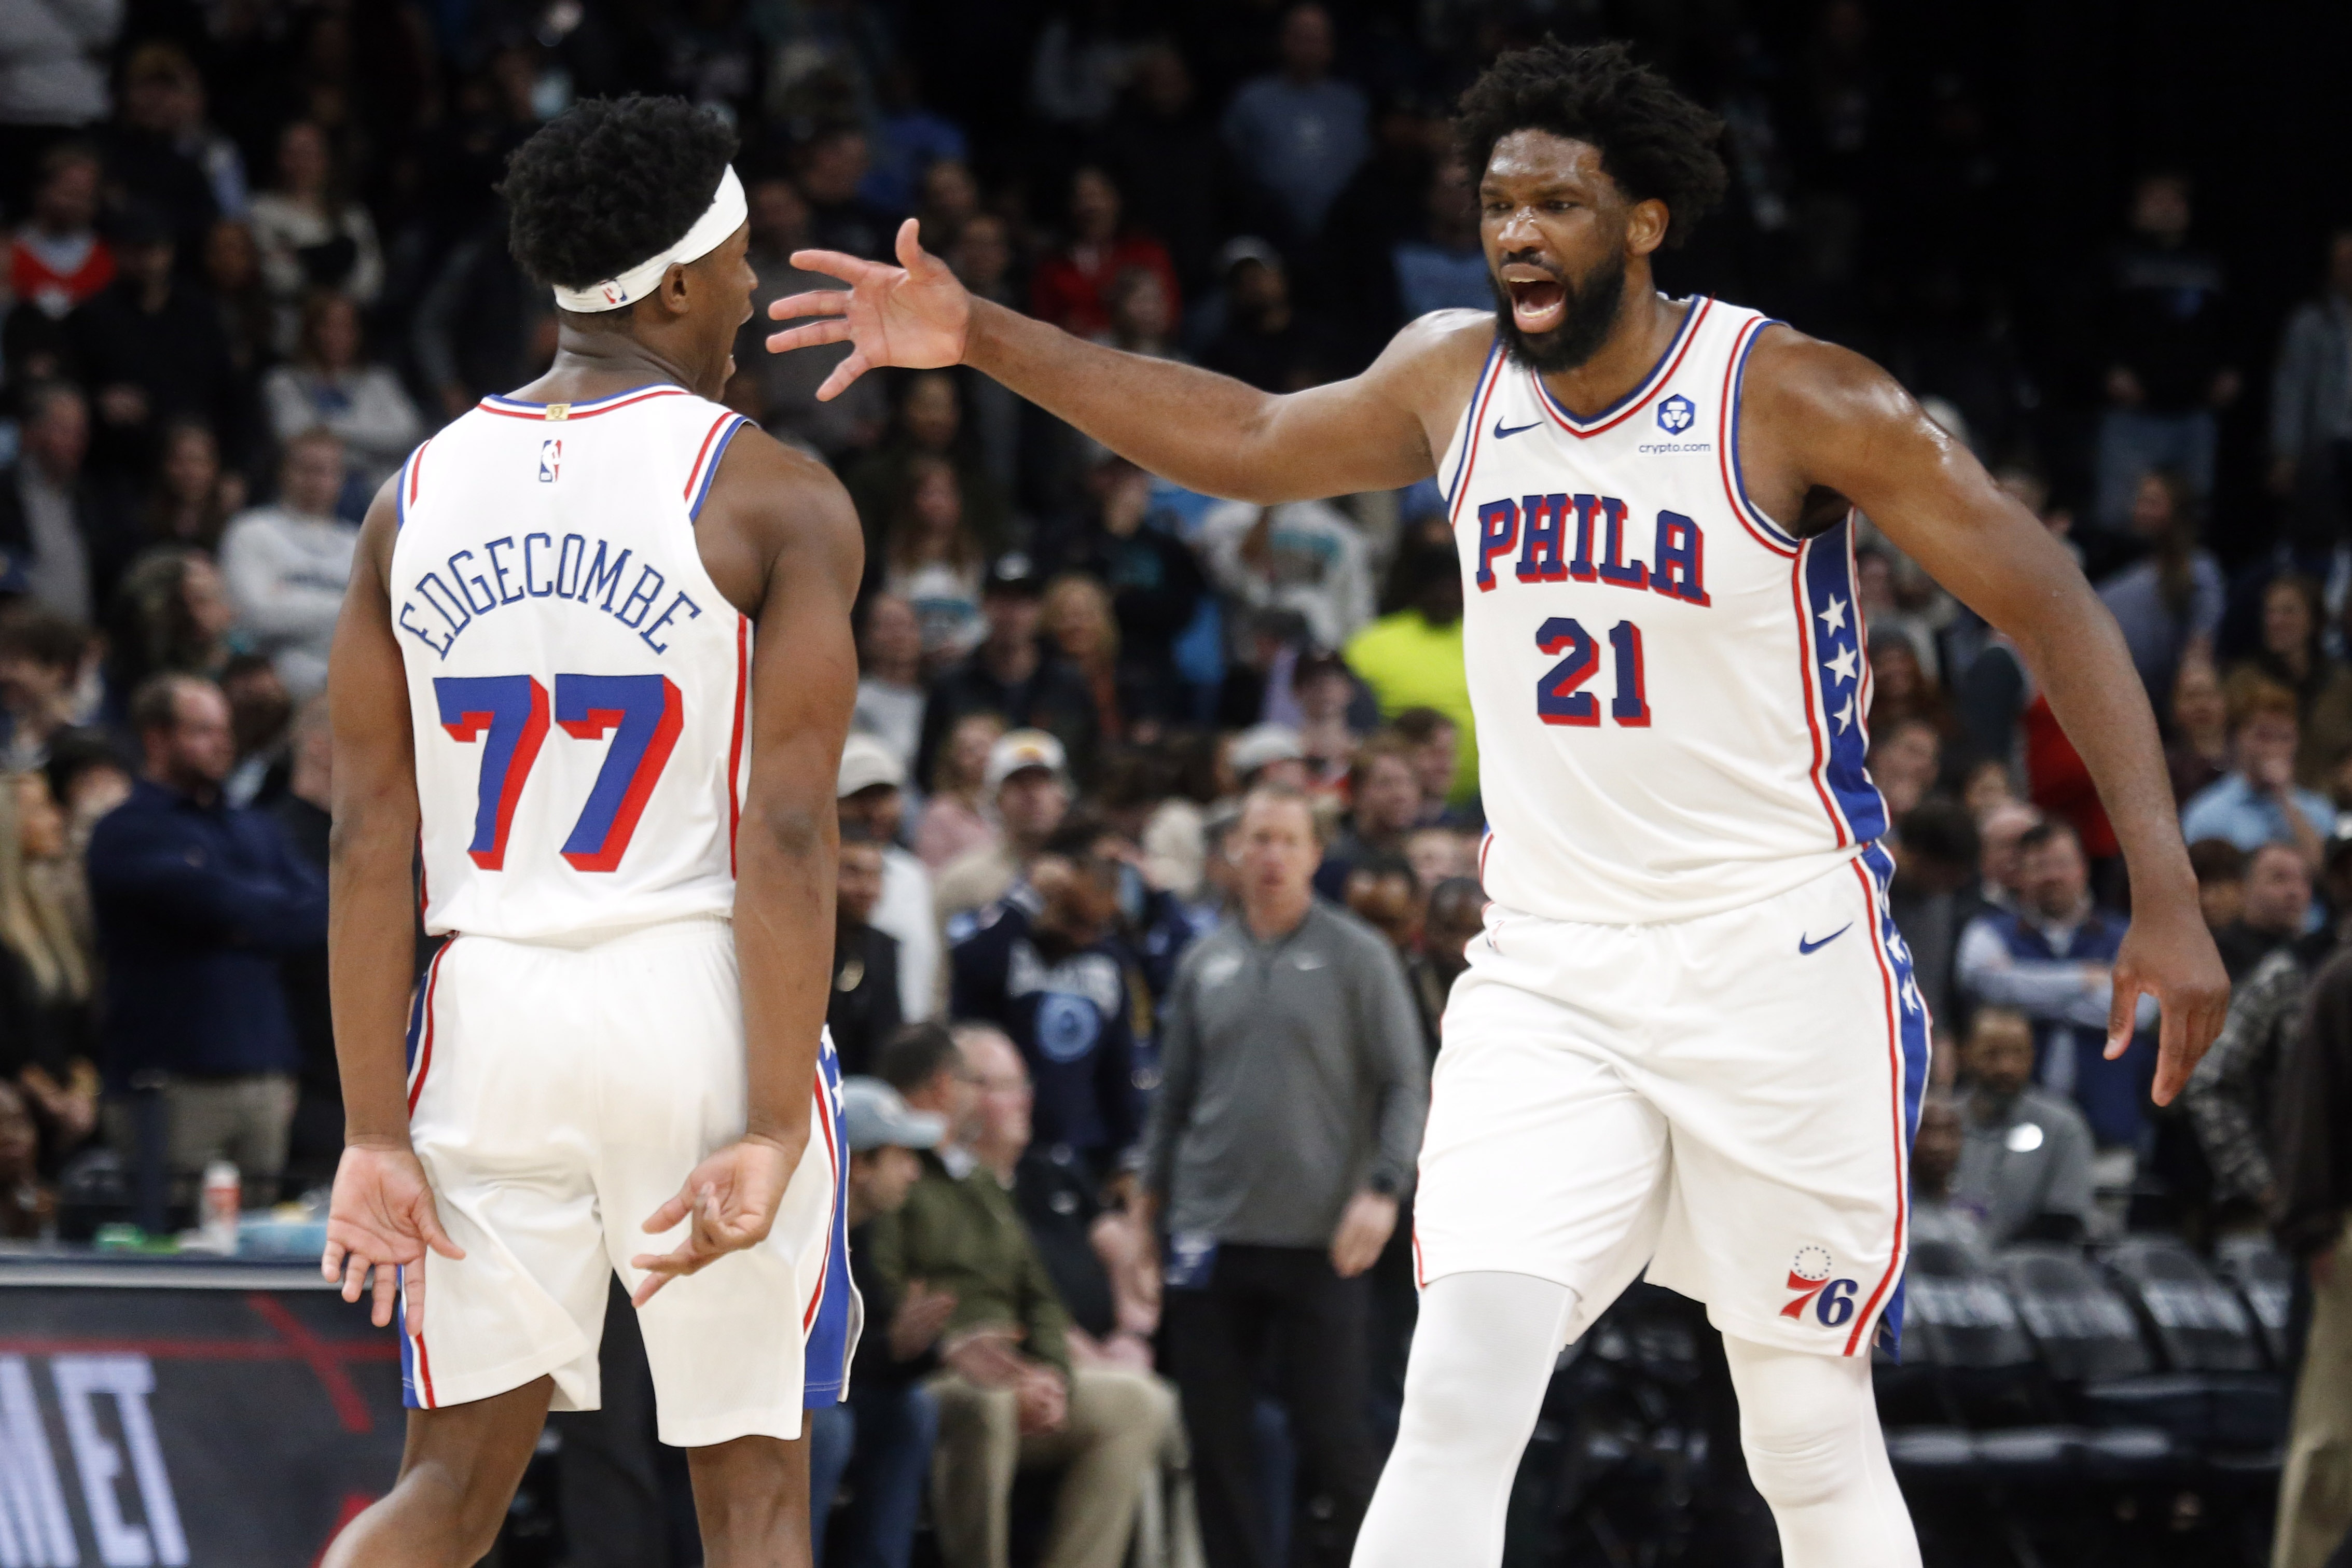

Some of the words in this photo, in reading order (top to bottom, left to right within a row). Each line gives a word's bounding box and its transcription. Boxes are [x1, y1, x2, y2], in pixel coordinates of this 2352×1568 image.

[1639, 443, 1711, 454] crypto.com
[399, 532, 702, 661] EDGECOMBE
[1476, 493, 1711, 607] PHILA
[1535, 617, 1651, 728] 21
[433, 673, 684, 872] 77
[1779, 1269, 1858, 1327] 76
